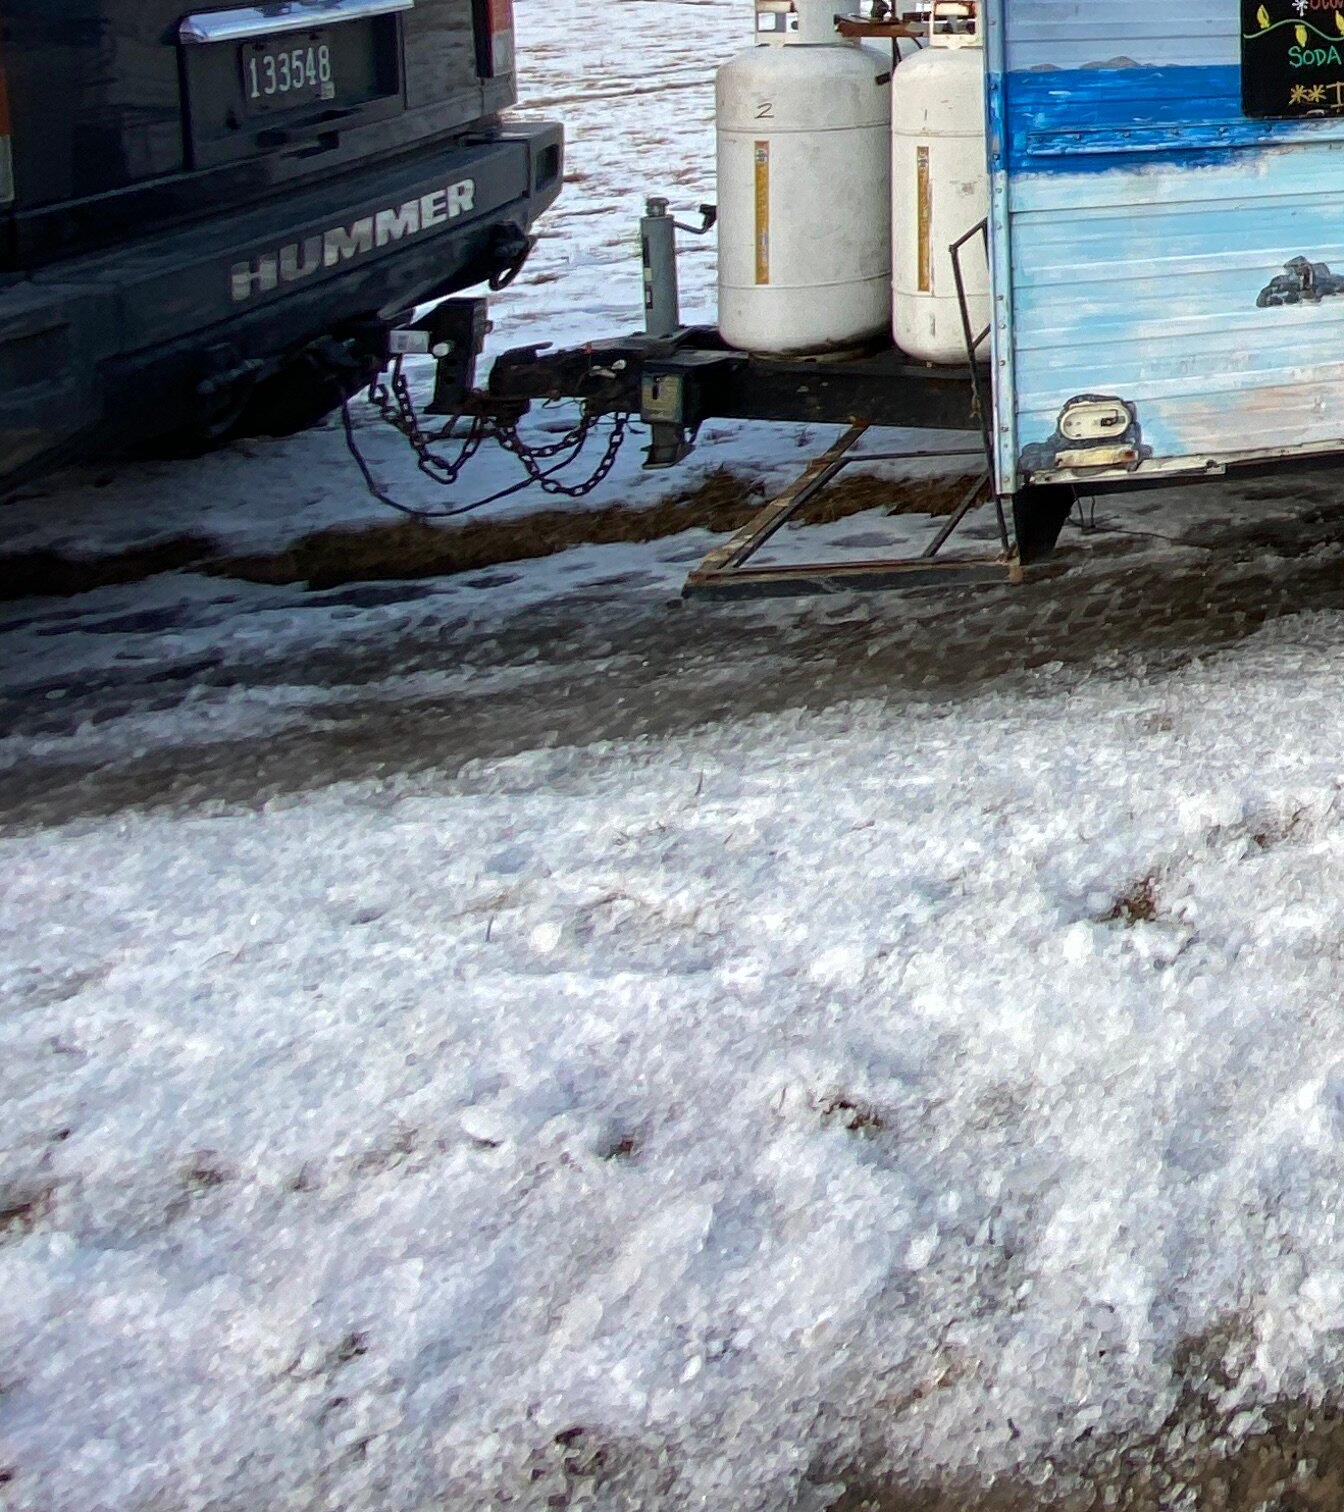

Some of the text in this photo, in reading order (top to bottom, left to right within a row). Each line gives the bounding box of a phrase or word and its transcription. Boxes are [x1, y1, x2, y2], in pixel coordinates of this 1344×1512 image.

[247, 44, 332, 99] 133548
[754, 102, 775, 120] 2
[230, 178, 476, 302] HUMMER
